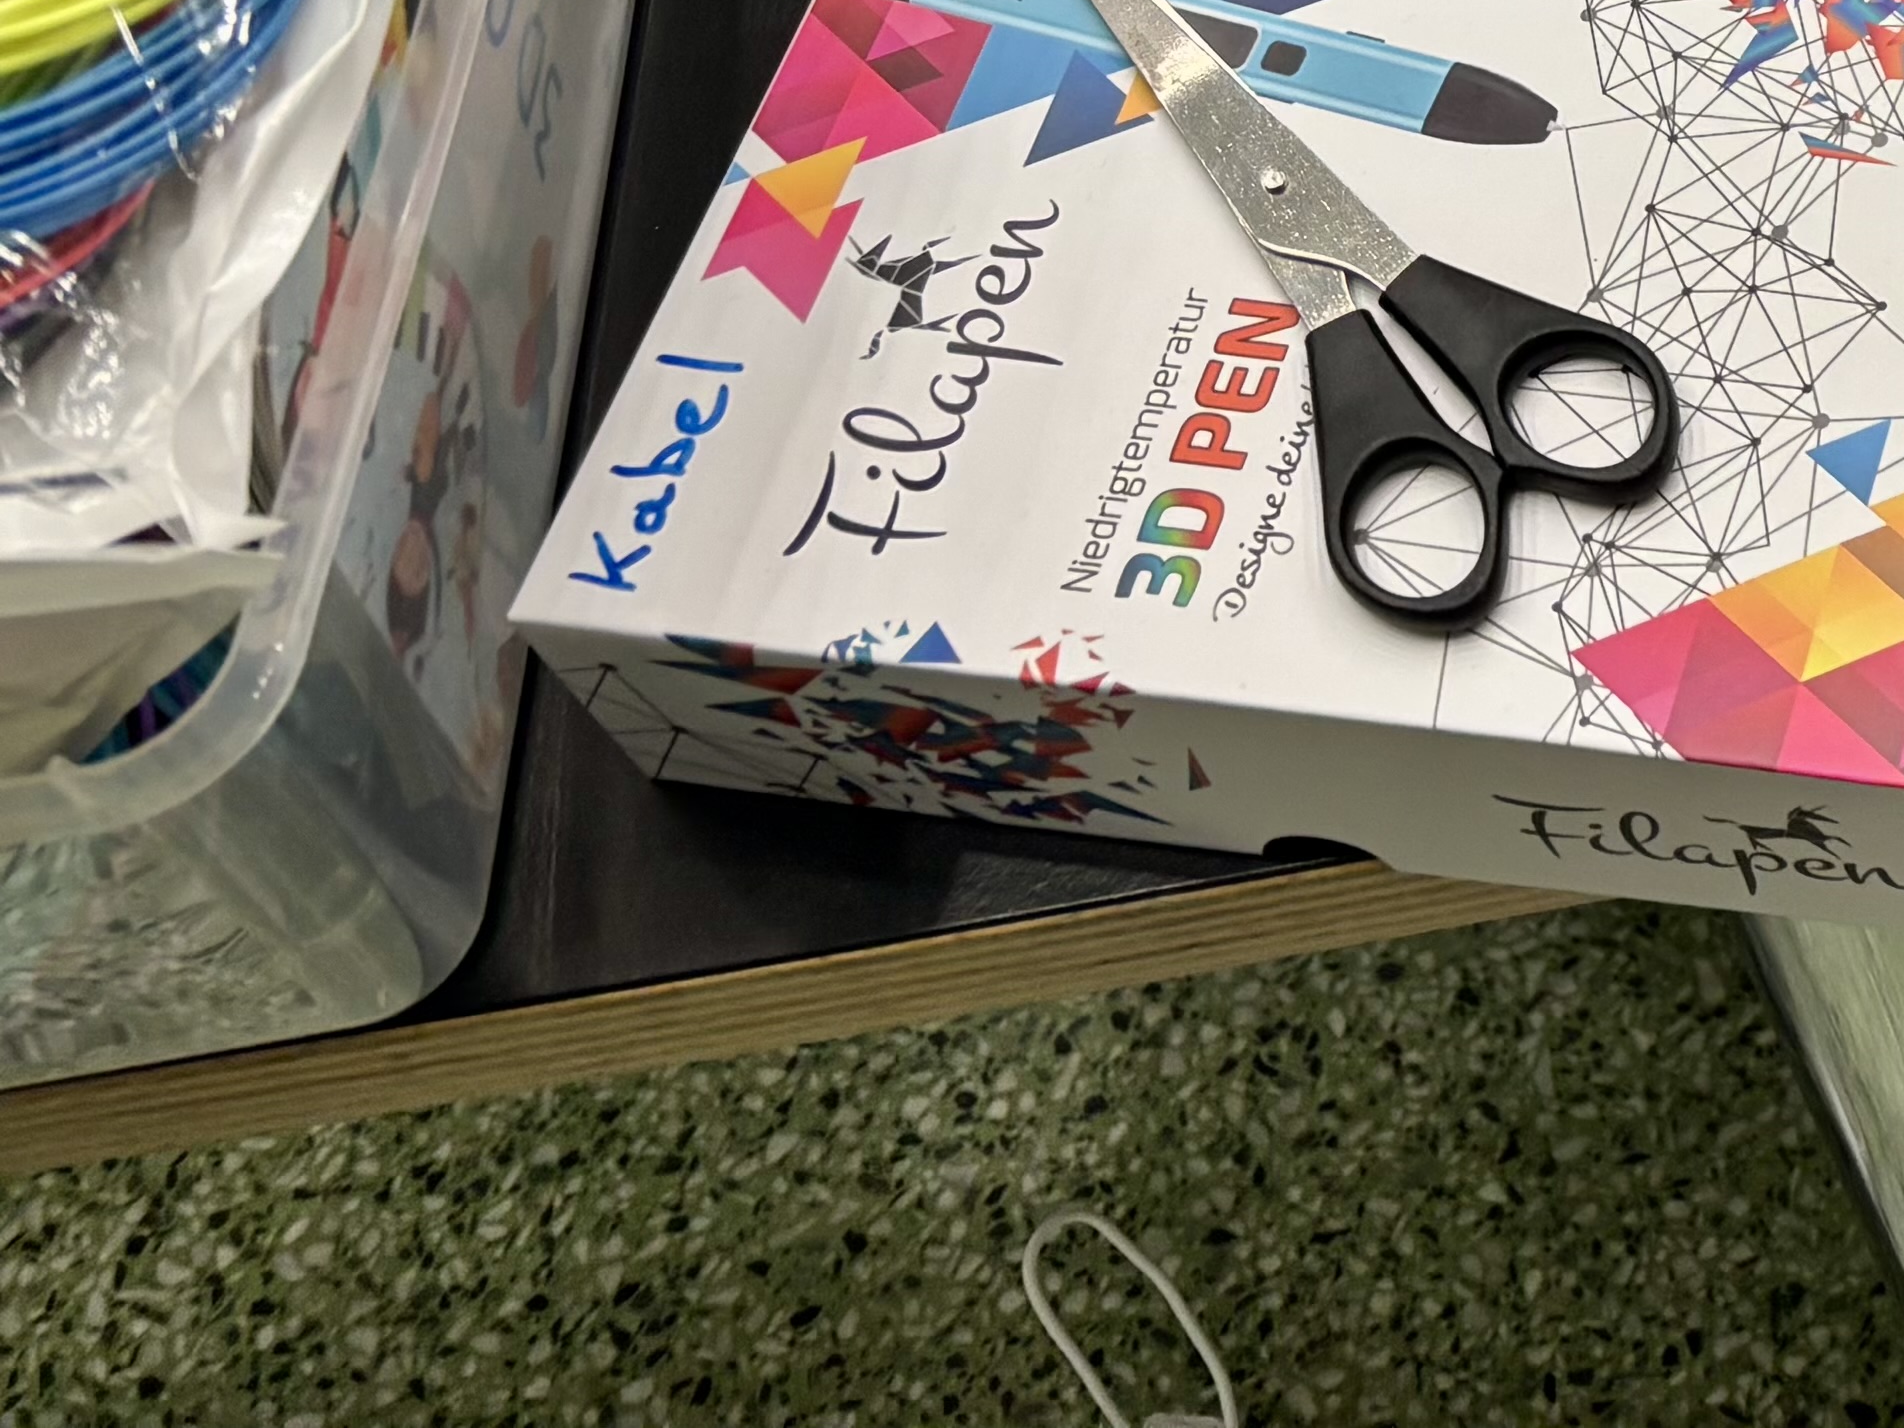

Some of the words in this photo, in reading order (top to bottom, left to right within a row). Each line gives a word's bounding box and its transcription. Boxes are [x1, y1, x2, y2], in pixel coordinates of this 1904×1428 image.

[568, 352, 745, 595] Kabel
[782, 197, 1065, 559] Filapen
[1059, 286, 1209, 593] Niedrigtemperatur
[1168, 297, 1301, 471] PEN
[1114, 487, 1226, 608] 3D
[1212, 490, 1296, 622] Designe
